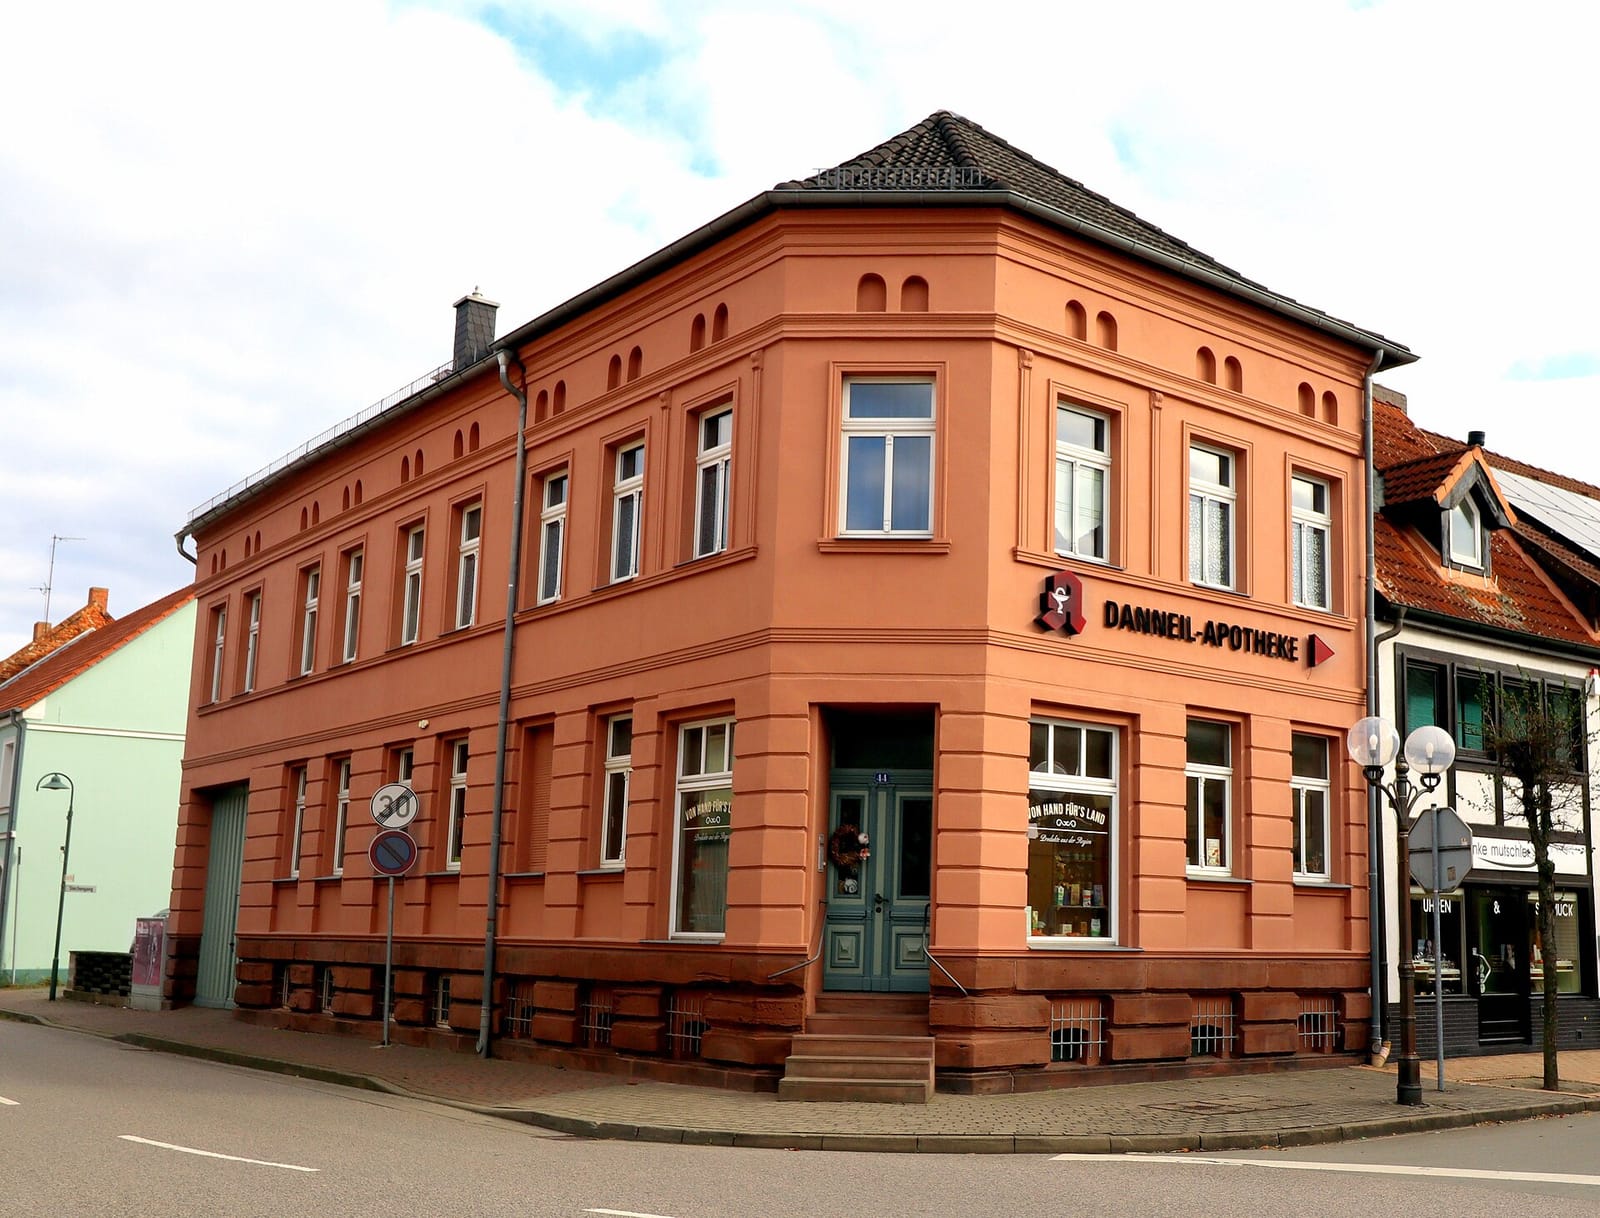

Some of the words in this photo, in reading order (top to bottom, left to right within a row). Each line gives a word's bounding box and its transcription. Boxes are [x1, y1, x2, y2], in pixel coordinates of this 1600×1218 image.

[1104, 600, 1299, 661] DANNEIL-APOTHEKE
[379, 795, 411, 818] 30
[1042, 803, 1064, 816] HAND
[1065, 802, 1085, 818] FÜR'S
[1086, 808, 1106, 825] LAND
[1423, 898, 1452, 913] UHEN
[1493, 900, 1501, 914] &
